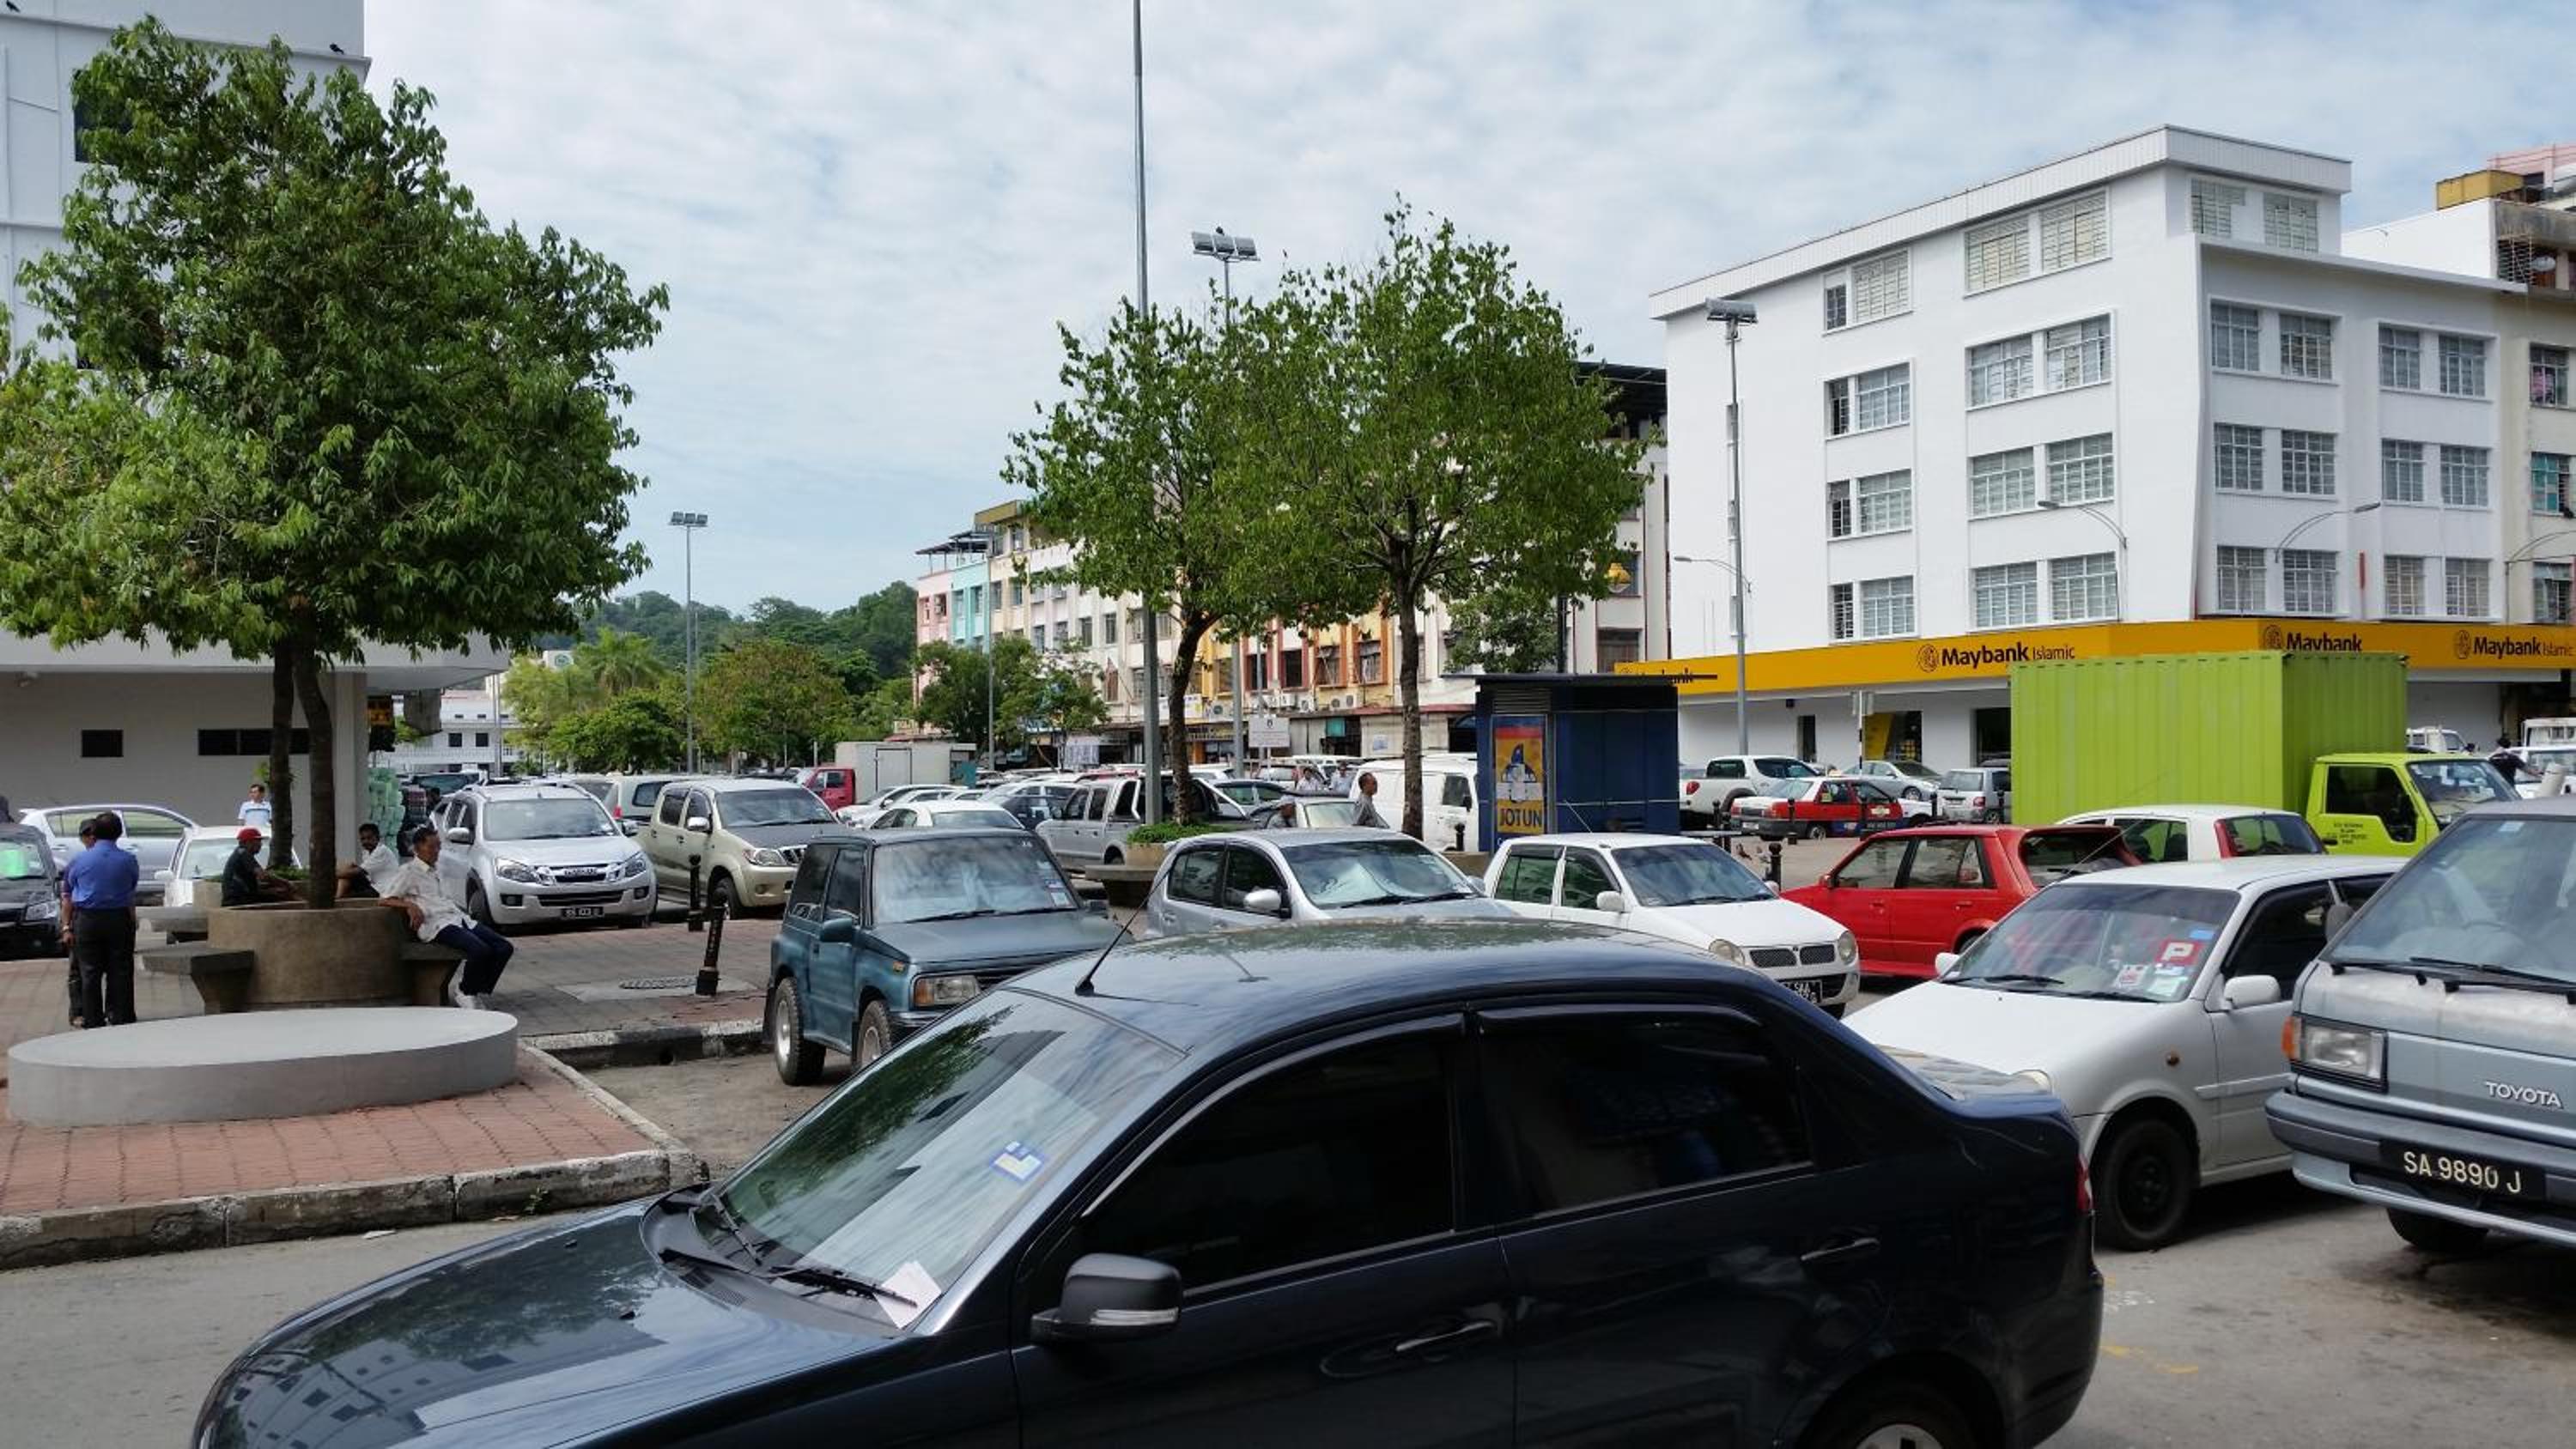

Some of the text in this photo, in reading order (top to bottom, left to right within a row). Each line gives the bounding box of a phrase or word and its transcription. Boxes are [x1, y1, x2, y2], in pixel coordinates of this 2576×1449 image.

[2286, 631, 2362, 652] Maybank
[2473, 636, 2542, 659] Maybank
[1941, 641, 2075, 670] Maybank Islamic
[1499, 808, 1542, 828] JOTUN
[2160, 942, 2195, 961] P
[2485, 1081, 2563, 1108] TOYOTA
[2403, 1150, 2522, 1194] SA 9890 J
